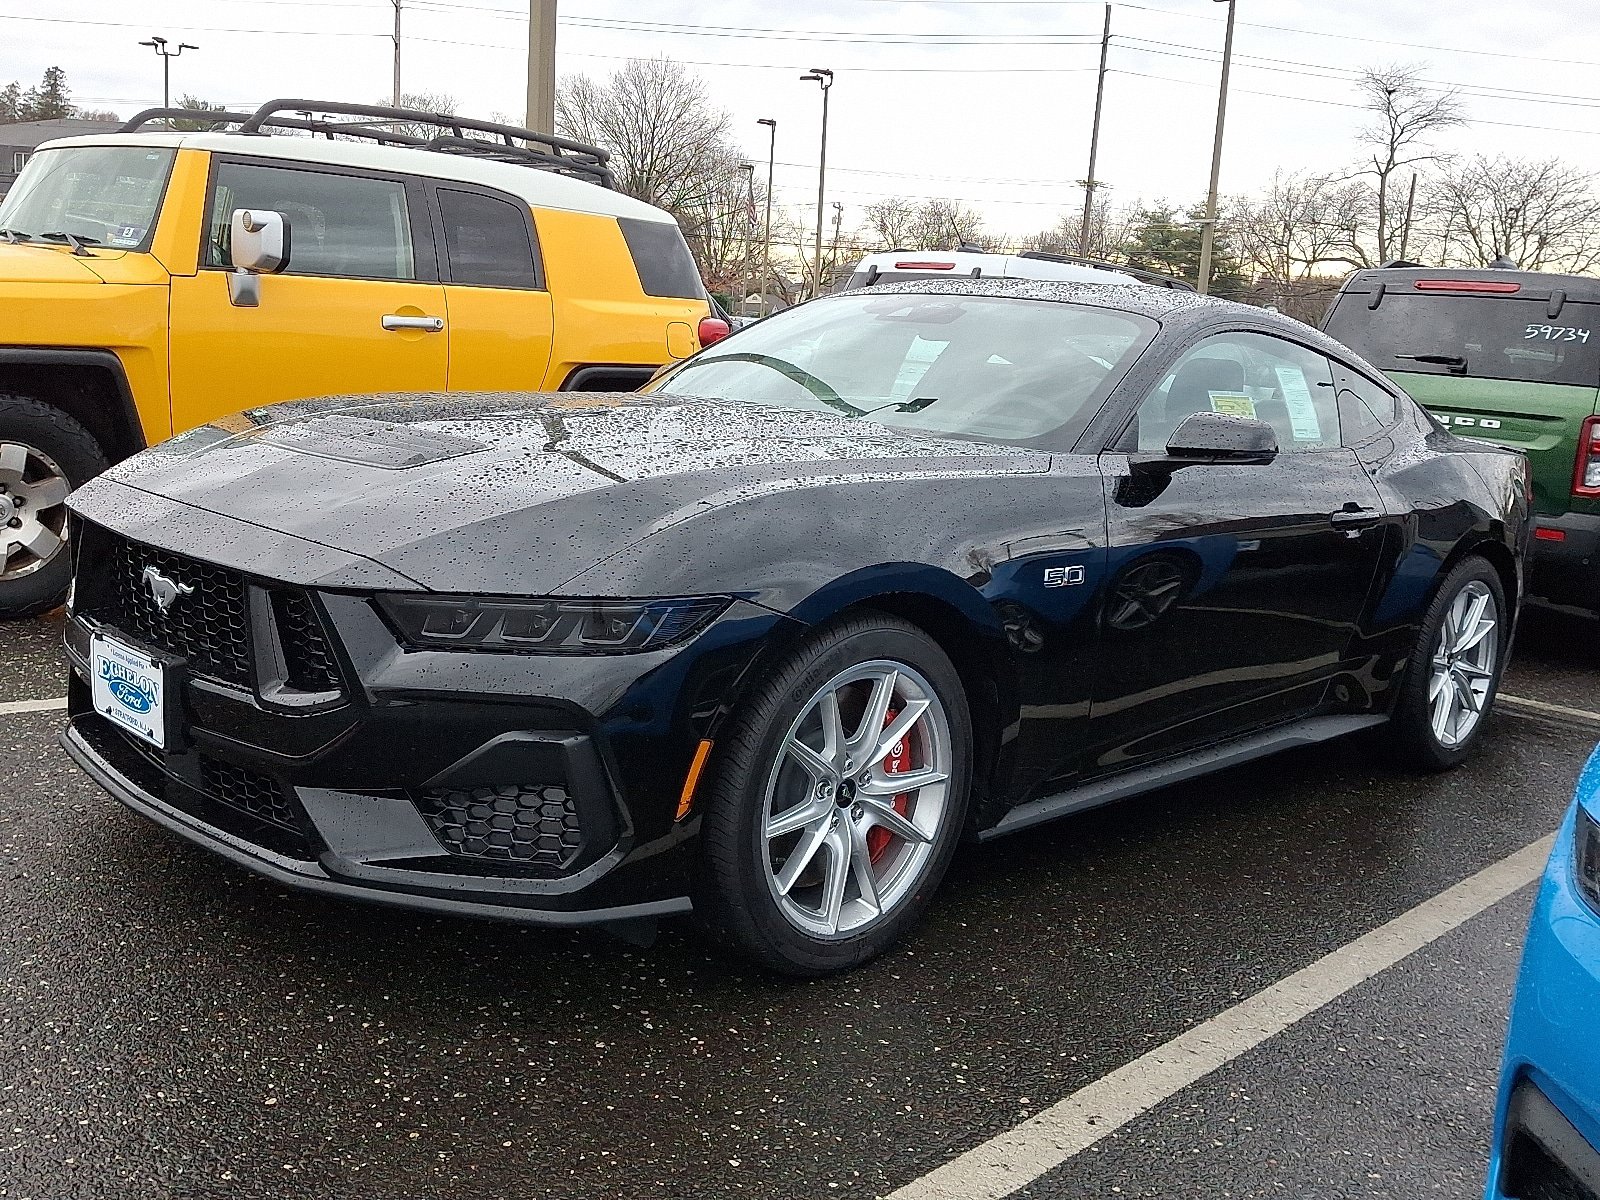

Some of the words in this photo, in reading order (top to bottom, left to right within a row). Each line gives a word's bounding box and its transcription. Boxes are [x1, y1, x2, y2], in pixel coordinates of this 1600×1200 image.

[1524, 323, 1591, 344] 59734
[1043, 565, 1085, 588] 5.0
[97, 655, 160, 707] ECHELON
[116, 683, 143, 709] Ford
